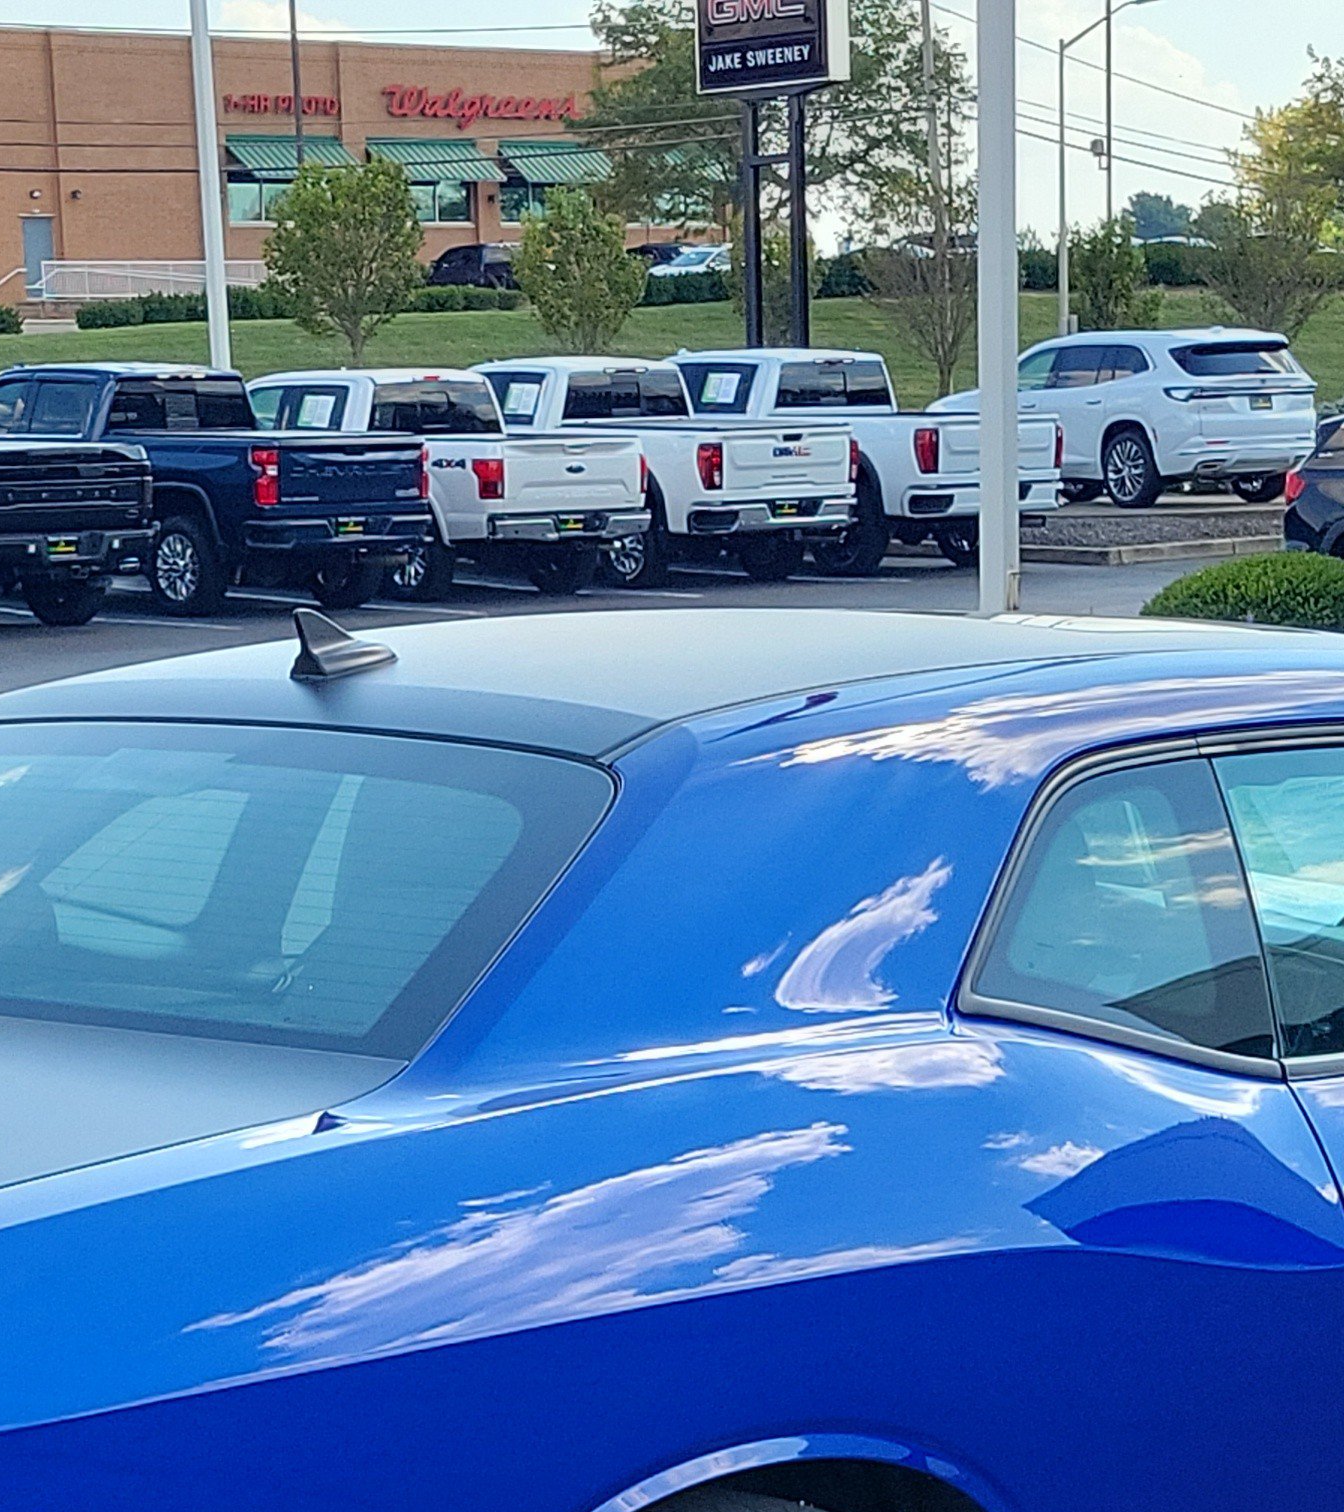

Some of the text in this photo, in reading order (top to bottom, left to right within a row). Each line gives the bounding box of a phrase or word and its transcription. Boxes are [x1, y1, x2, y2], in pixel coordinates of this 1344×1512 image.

[708, 0, 805, 25] GMC
[708, 44, 811, 72] JAKE SWEENEY
[381, 83, 581, 130] Walgreens
